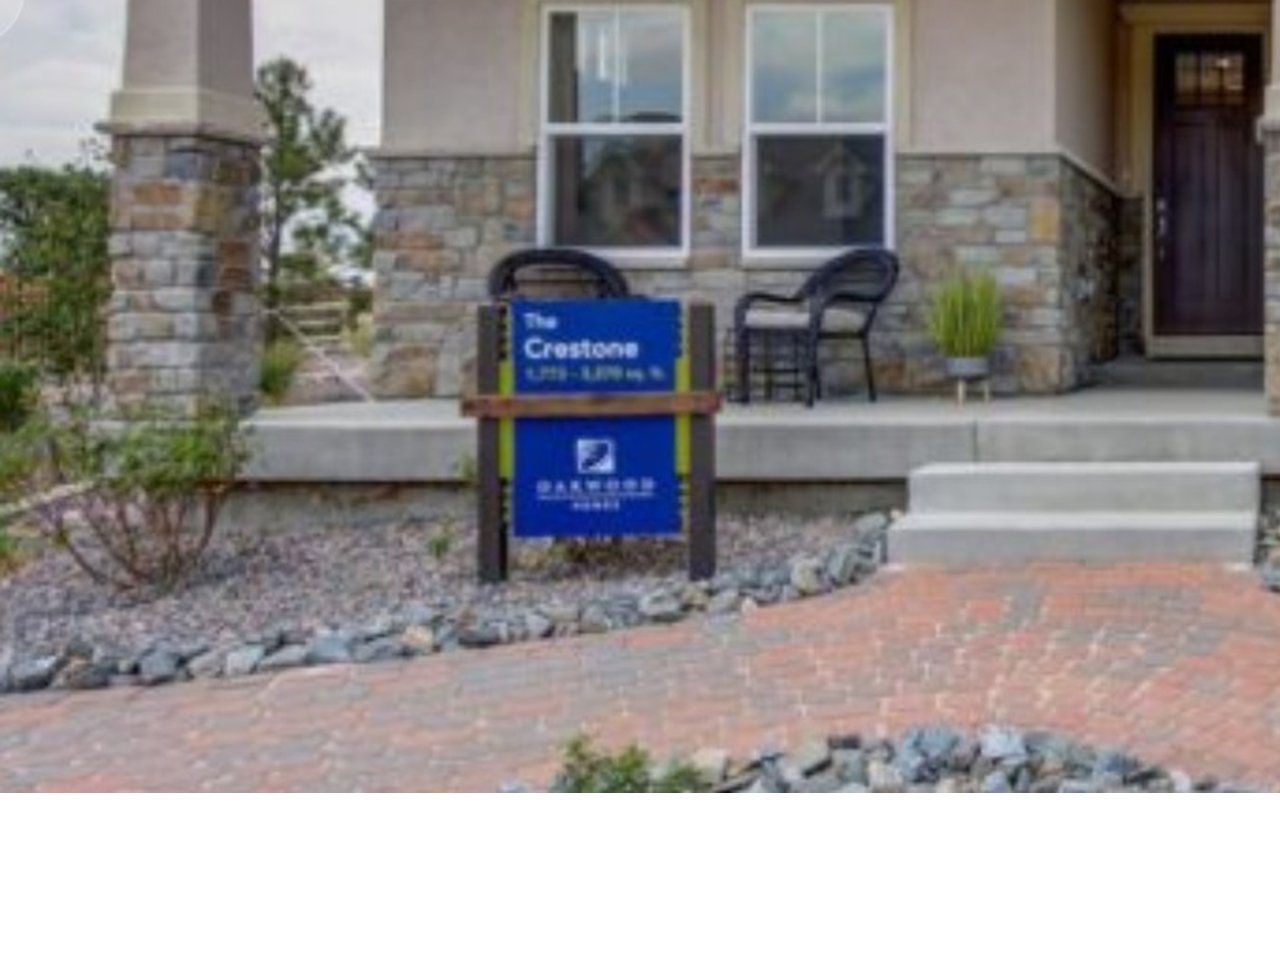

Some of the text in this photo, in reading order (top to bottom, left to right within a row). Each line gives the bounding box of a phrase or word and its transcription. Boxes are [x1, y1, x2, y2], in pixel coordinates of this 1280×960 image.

[524, 312, 558, 330] The
[524, 337, 639, 359] Crestone
[536, 477, 656, 494] OAKWOOD
